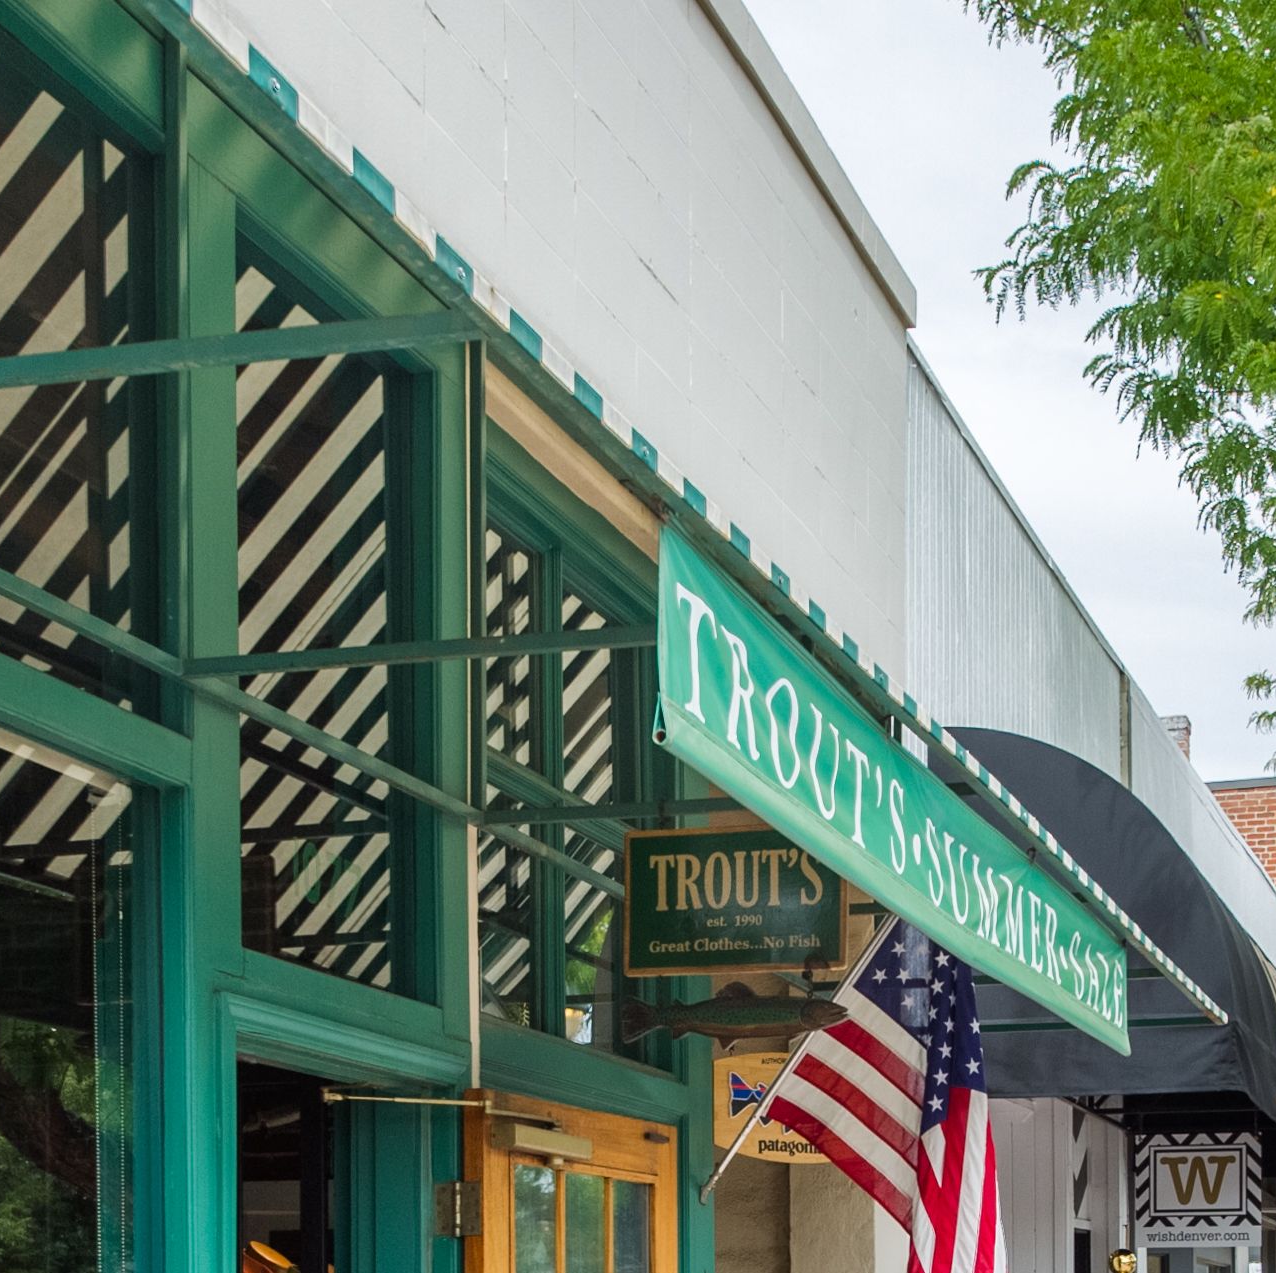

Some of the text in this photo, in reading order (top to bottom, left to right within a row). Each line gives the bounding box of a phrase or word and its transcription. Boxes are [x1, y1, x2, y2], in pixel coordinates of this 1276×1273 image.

[676, 582, 1124, 1028] TROUT'S SUMMER SALE
[649, 848, 824, 912] TROUT'S
[706, 915, 762, 928] est. 1990
[649, 940, 691, 953] Great
[788, 934, 821, 948] Fish
[1160, 1155, 1237, 1205] W
[1146, 1231, 1250, 1242] wishdenver.com
